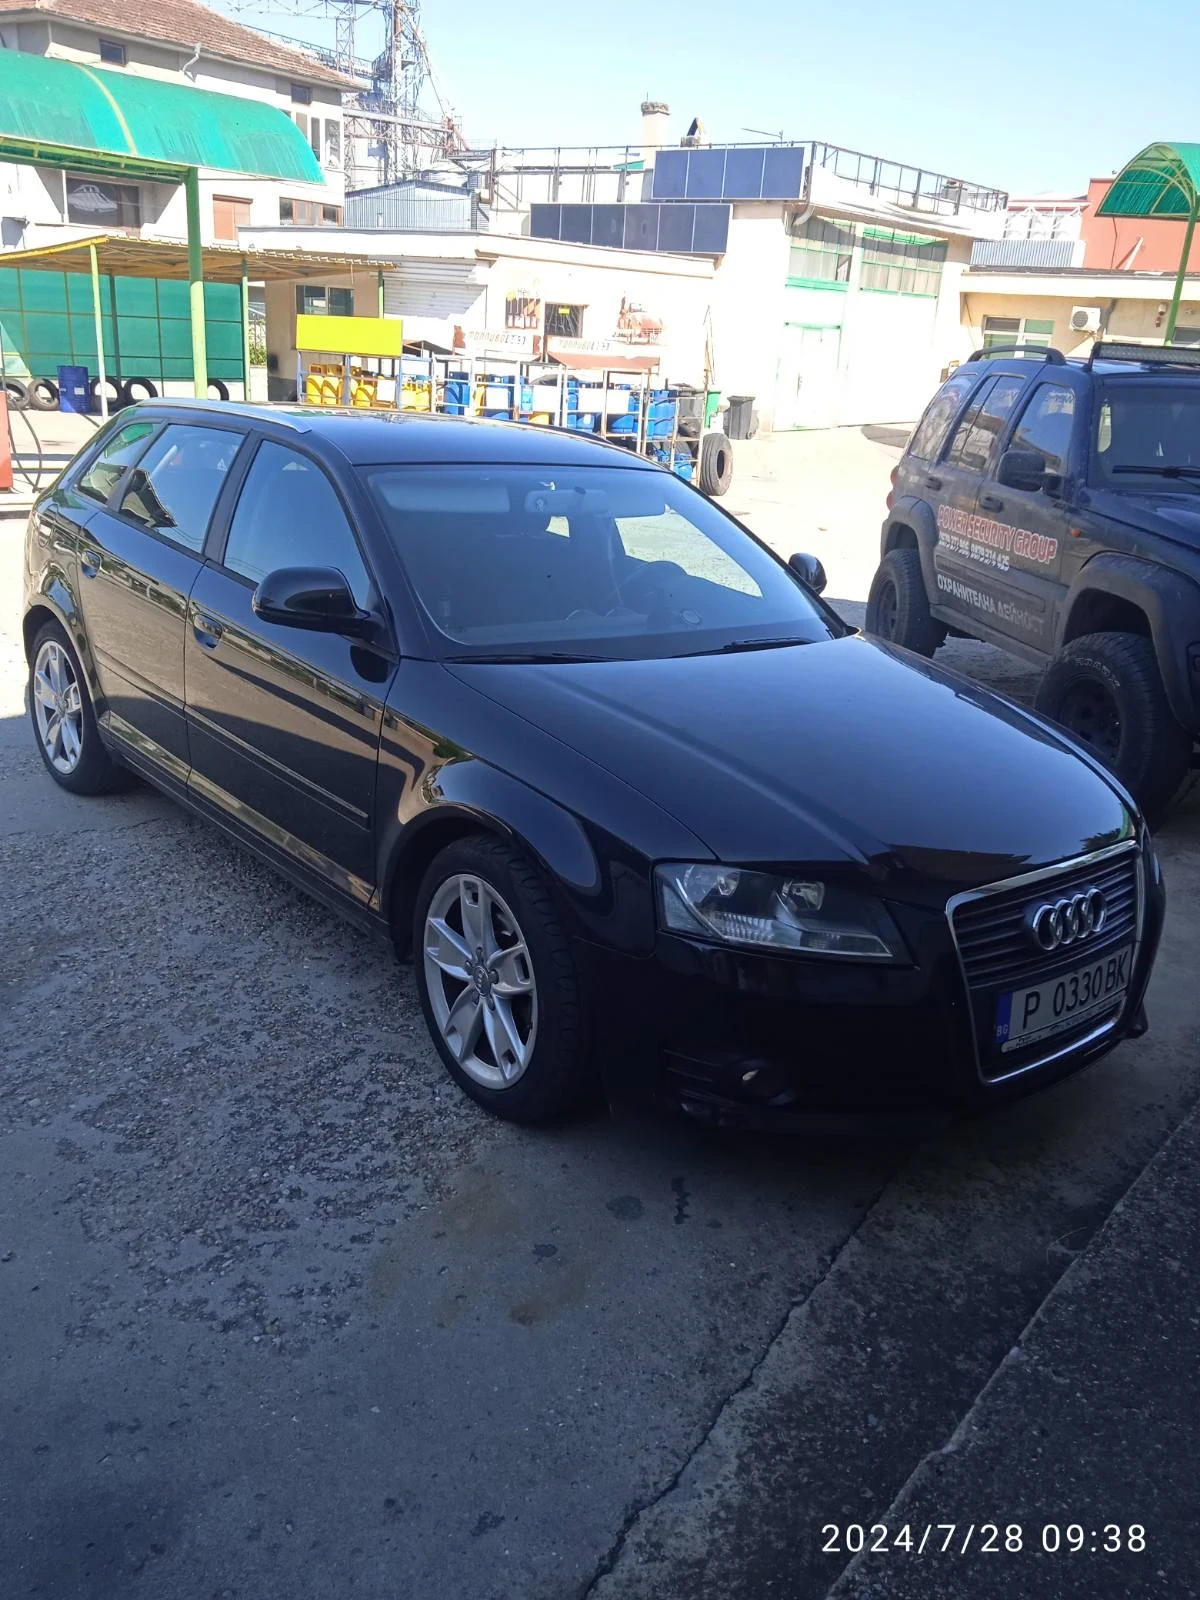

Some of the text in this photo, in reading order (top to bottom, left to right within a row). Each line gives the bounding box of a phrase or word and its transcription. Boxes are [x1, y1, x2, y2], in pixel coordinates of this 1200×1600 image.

[938, 504, 968, 535] POWER
[967, 514, 1015, 551] SECURITY
[1014, 529, 1058, 564] GROUP
[937, 573, 998, 614] ОХРАНИТЕЛНА
[1023, 991, 1041, 1029] P
[996, 1023, 1009, 1037] BG
